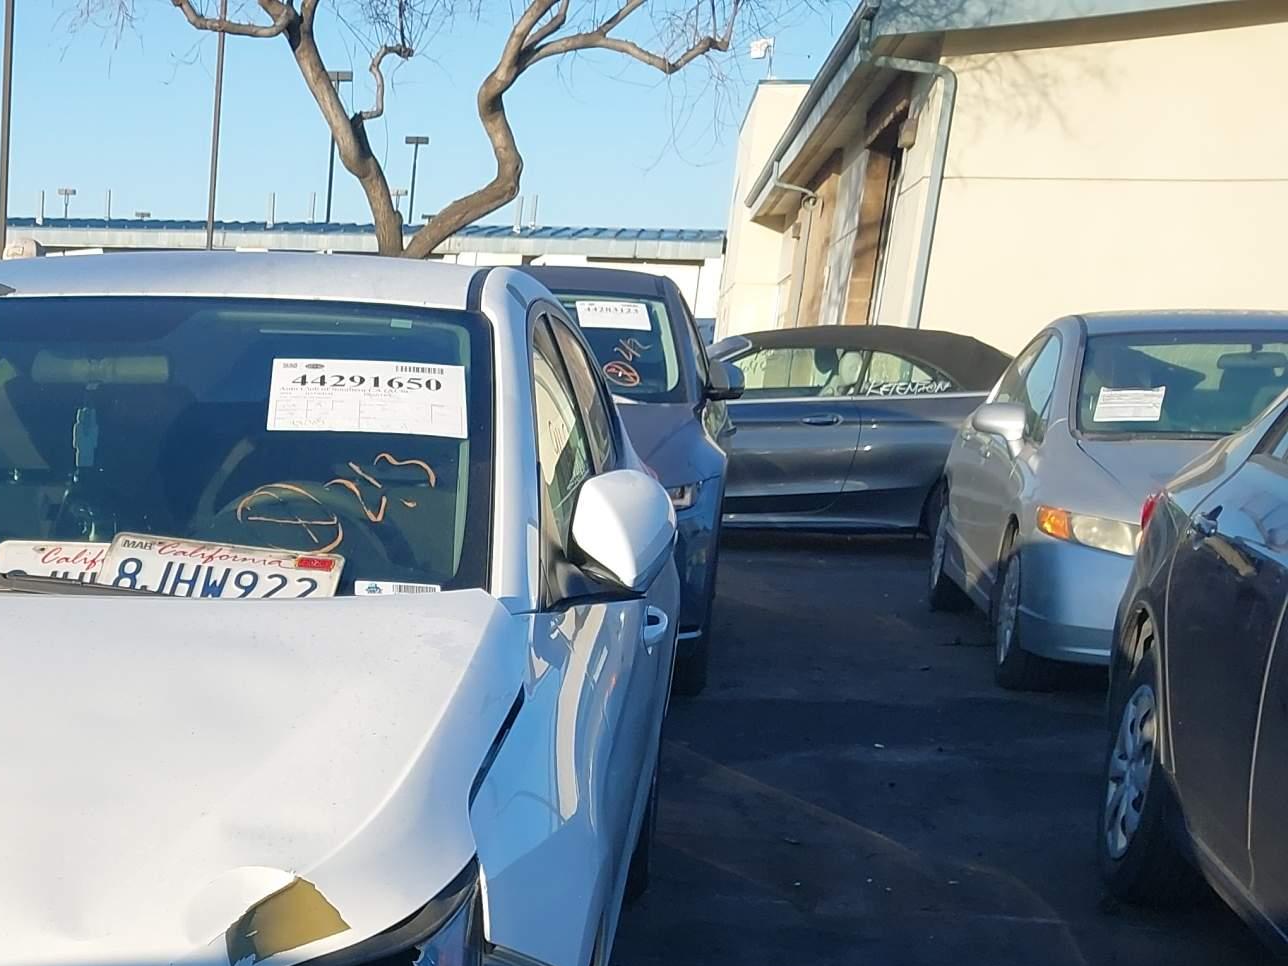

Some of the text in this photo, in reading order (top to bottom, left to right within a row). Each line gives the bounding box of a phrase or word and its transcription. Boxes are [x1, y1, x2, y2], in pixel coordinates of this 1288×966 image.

[291, 373, 442, 392] 44291650
[158, 542, 285, 568] California
[112, 557, 317, 598] 8JHW922
